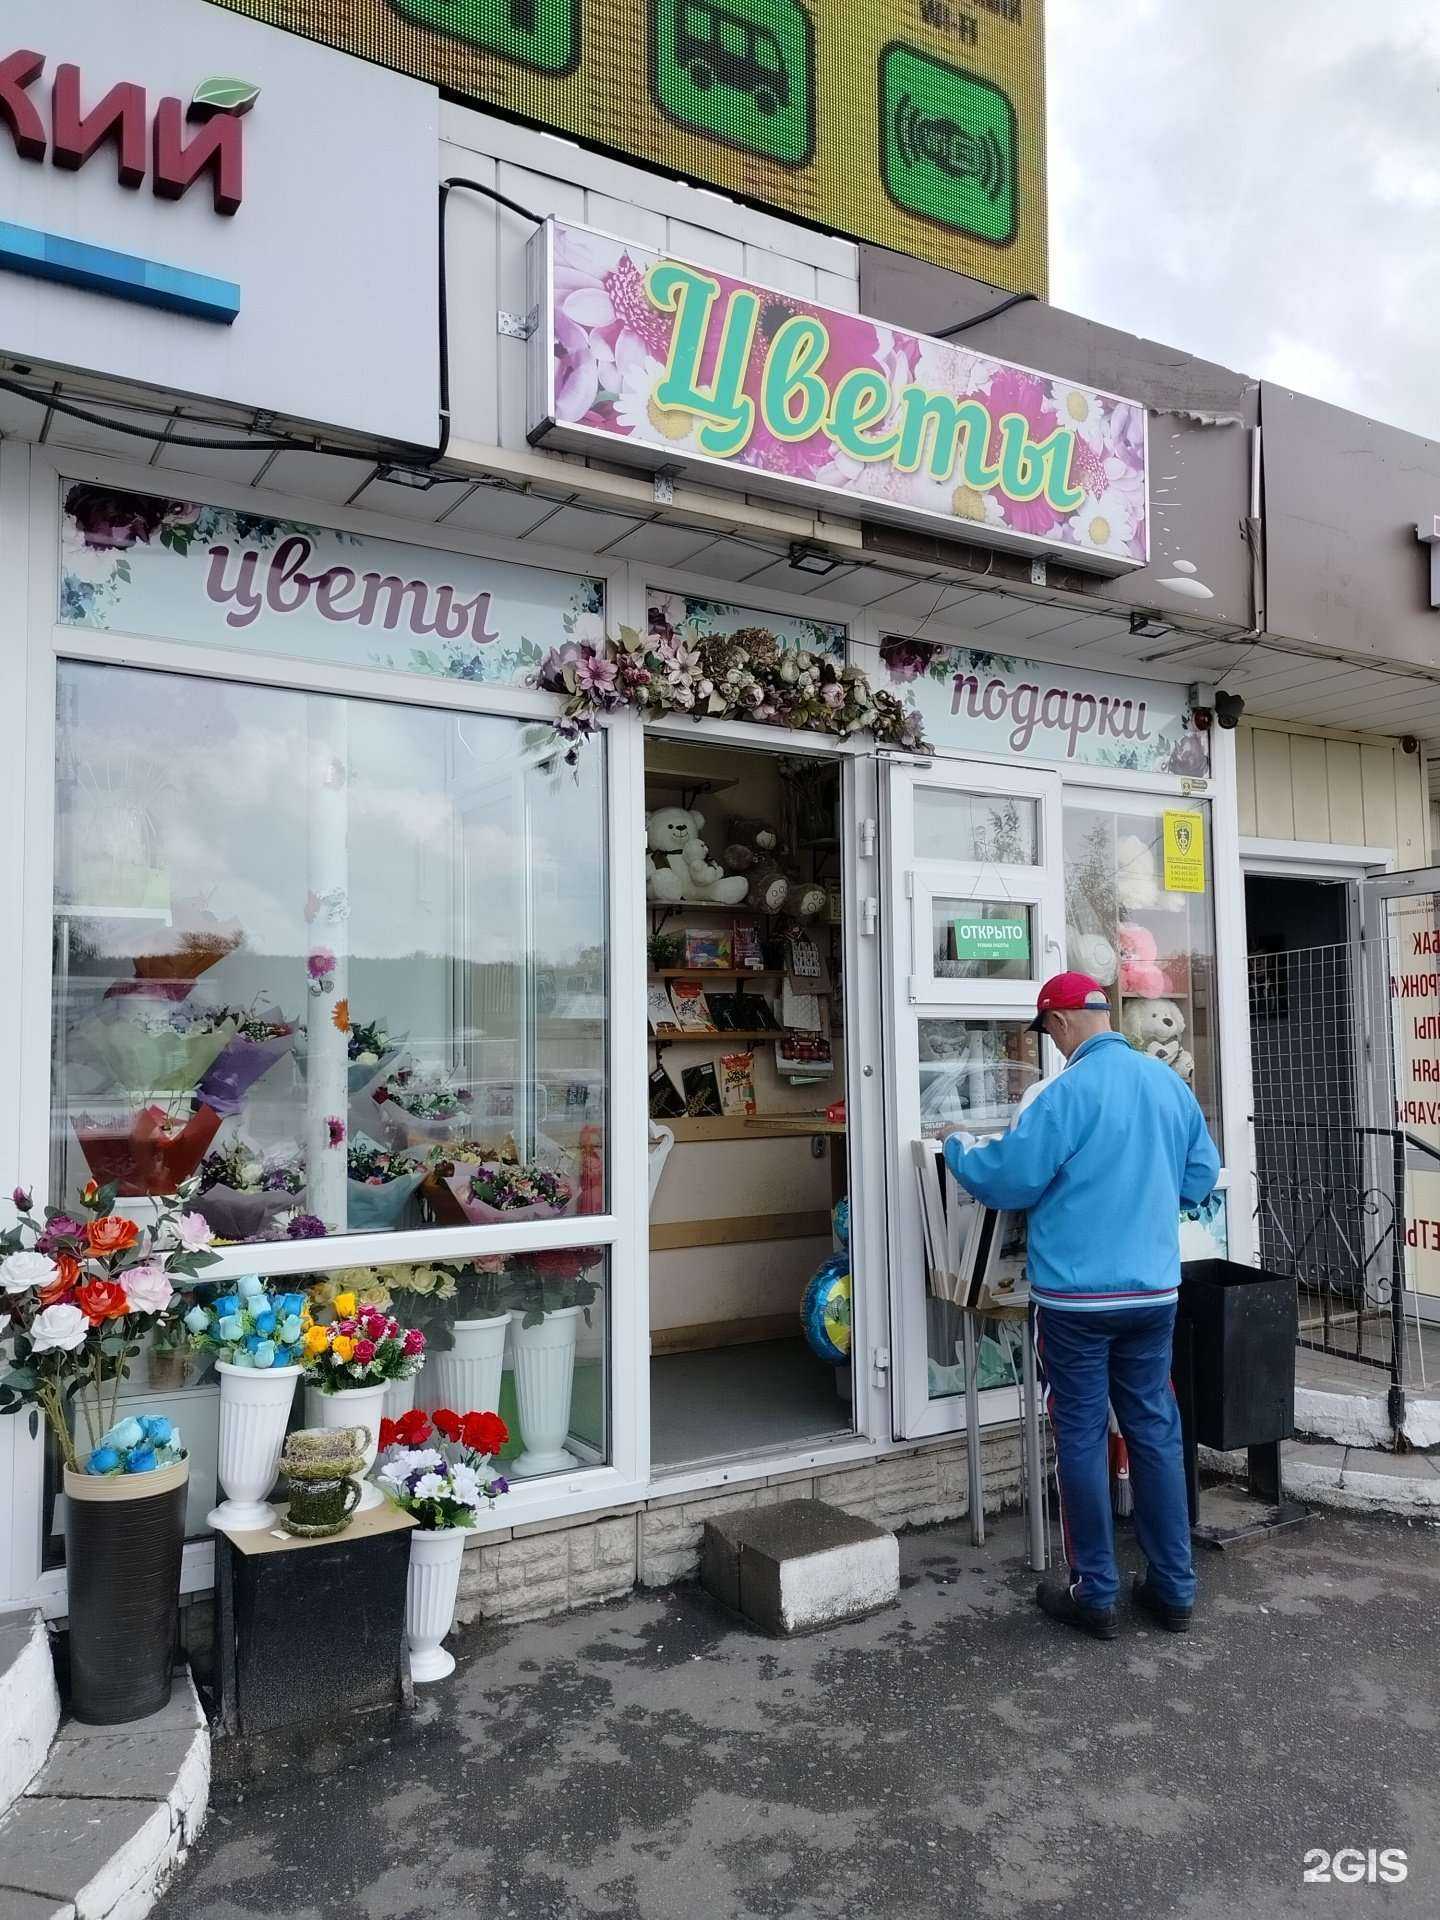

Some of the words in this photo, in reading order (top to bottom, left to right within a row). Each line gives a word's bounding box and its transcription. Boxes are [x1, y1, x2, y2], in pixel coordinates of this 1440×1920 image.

[645, 260, 1085, 512] Цветы
[206, 536, 499, 644] цветы
[950, 672, 1151, 758] подарки
[960, 925, 1023, 940] ОТКРЫТО
